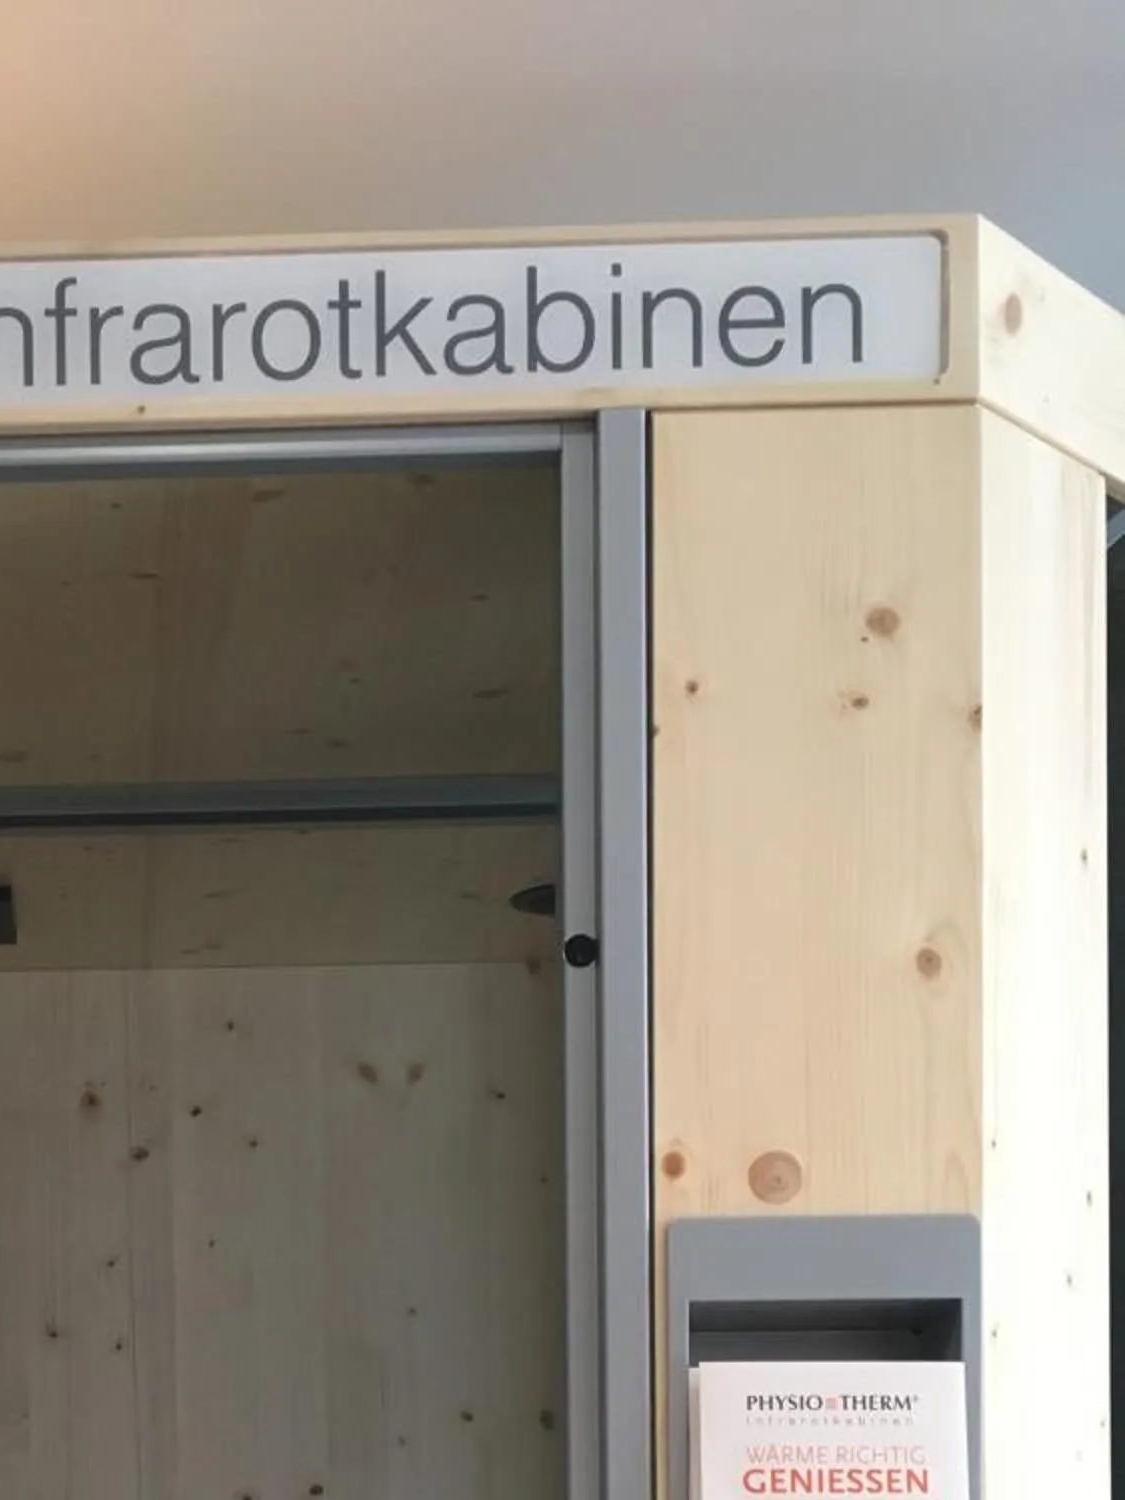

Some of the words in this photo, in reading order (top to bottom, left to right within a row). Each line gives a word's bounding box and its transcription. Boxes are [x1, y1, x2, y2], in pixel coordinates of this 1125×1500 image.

[746, 1394, 823, 1411] PHYSIO
[836, 1446, 926, 1465] RICHTIG
[742, 1468, 929, 1494] GENIESSEN
